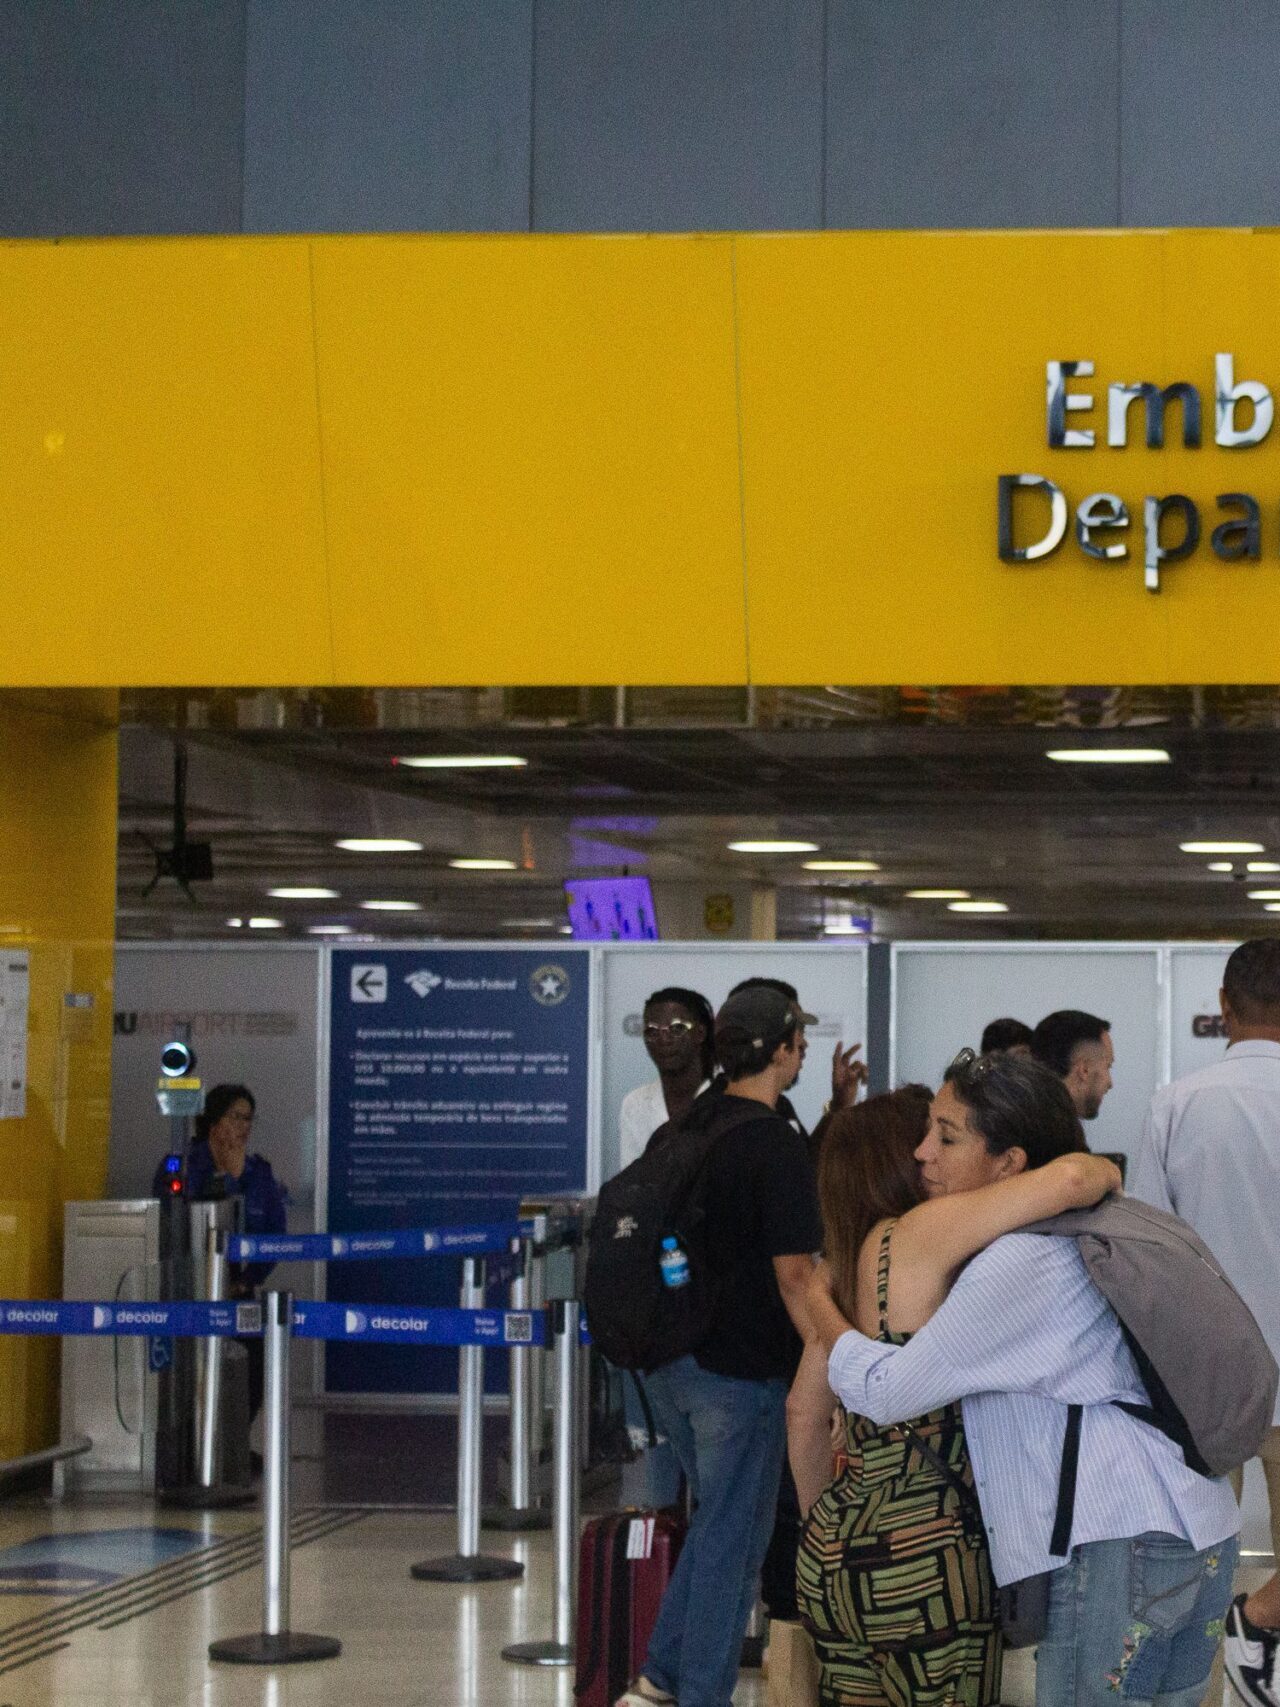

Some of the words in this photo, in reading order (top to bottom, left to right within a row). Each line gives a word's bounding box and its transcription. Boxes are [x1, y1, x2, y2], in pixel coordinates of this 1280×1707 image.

[445, 978, 480, 990] Receita
[482, 978, 517, 990] Federal
[352, 1239, 396, 1252] decolar
[444, 1233, 487, 1246] decolar
[259, 1241, 304, 1253] decolar
[8, 1310, 59, 1324] decolar
[116, 1311, 169, 1325] decolar
[371, 1316, 429, 1331] decolar
